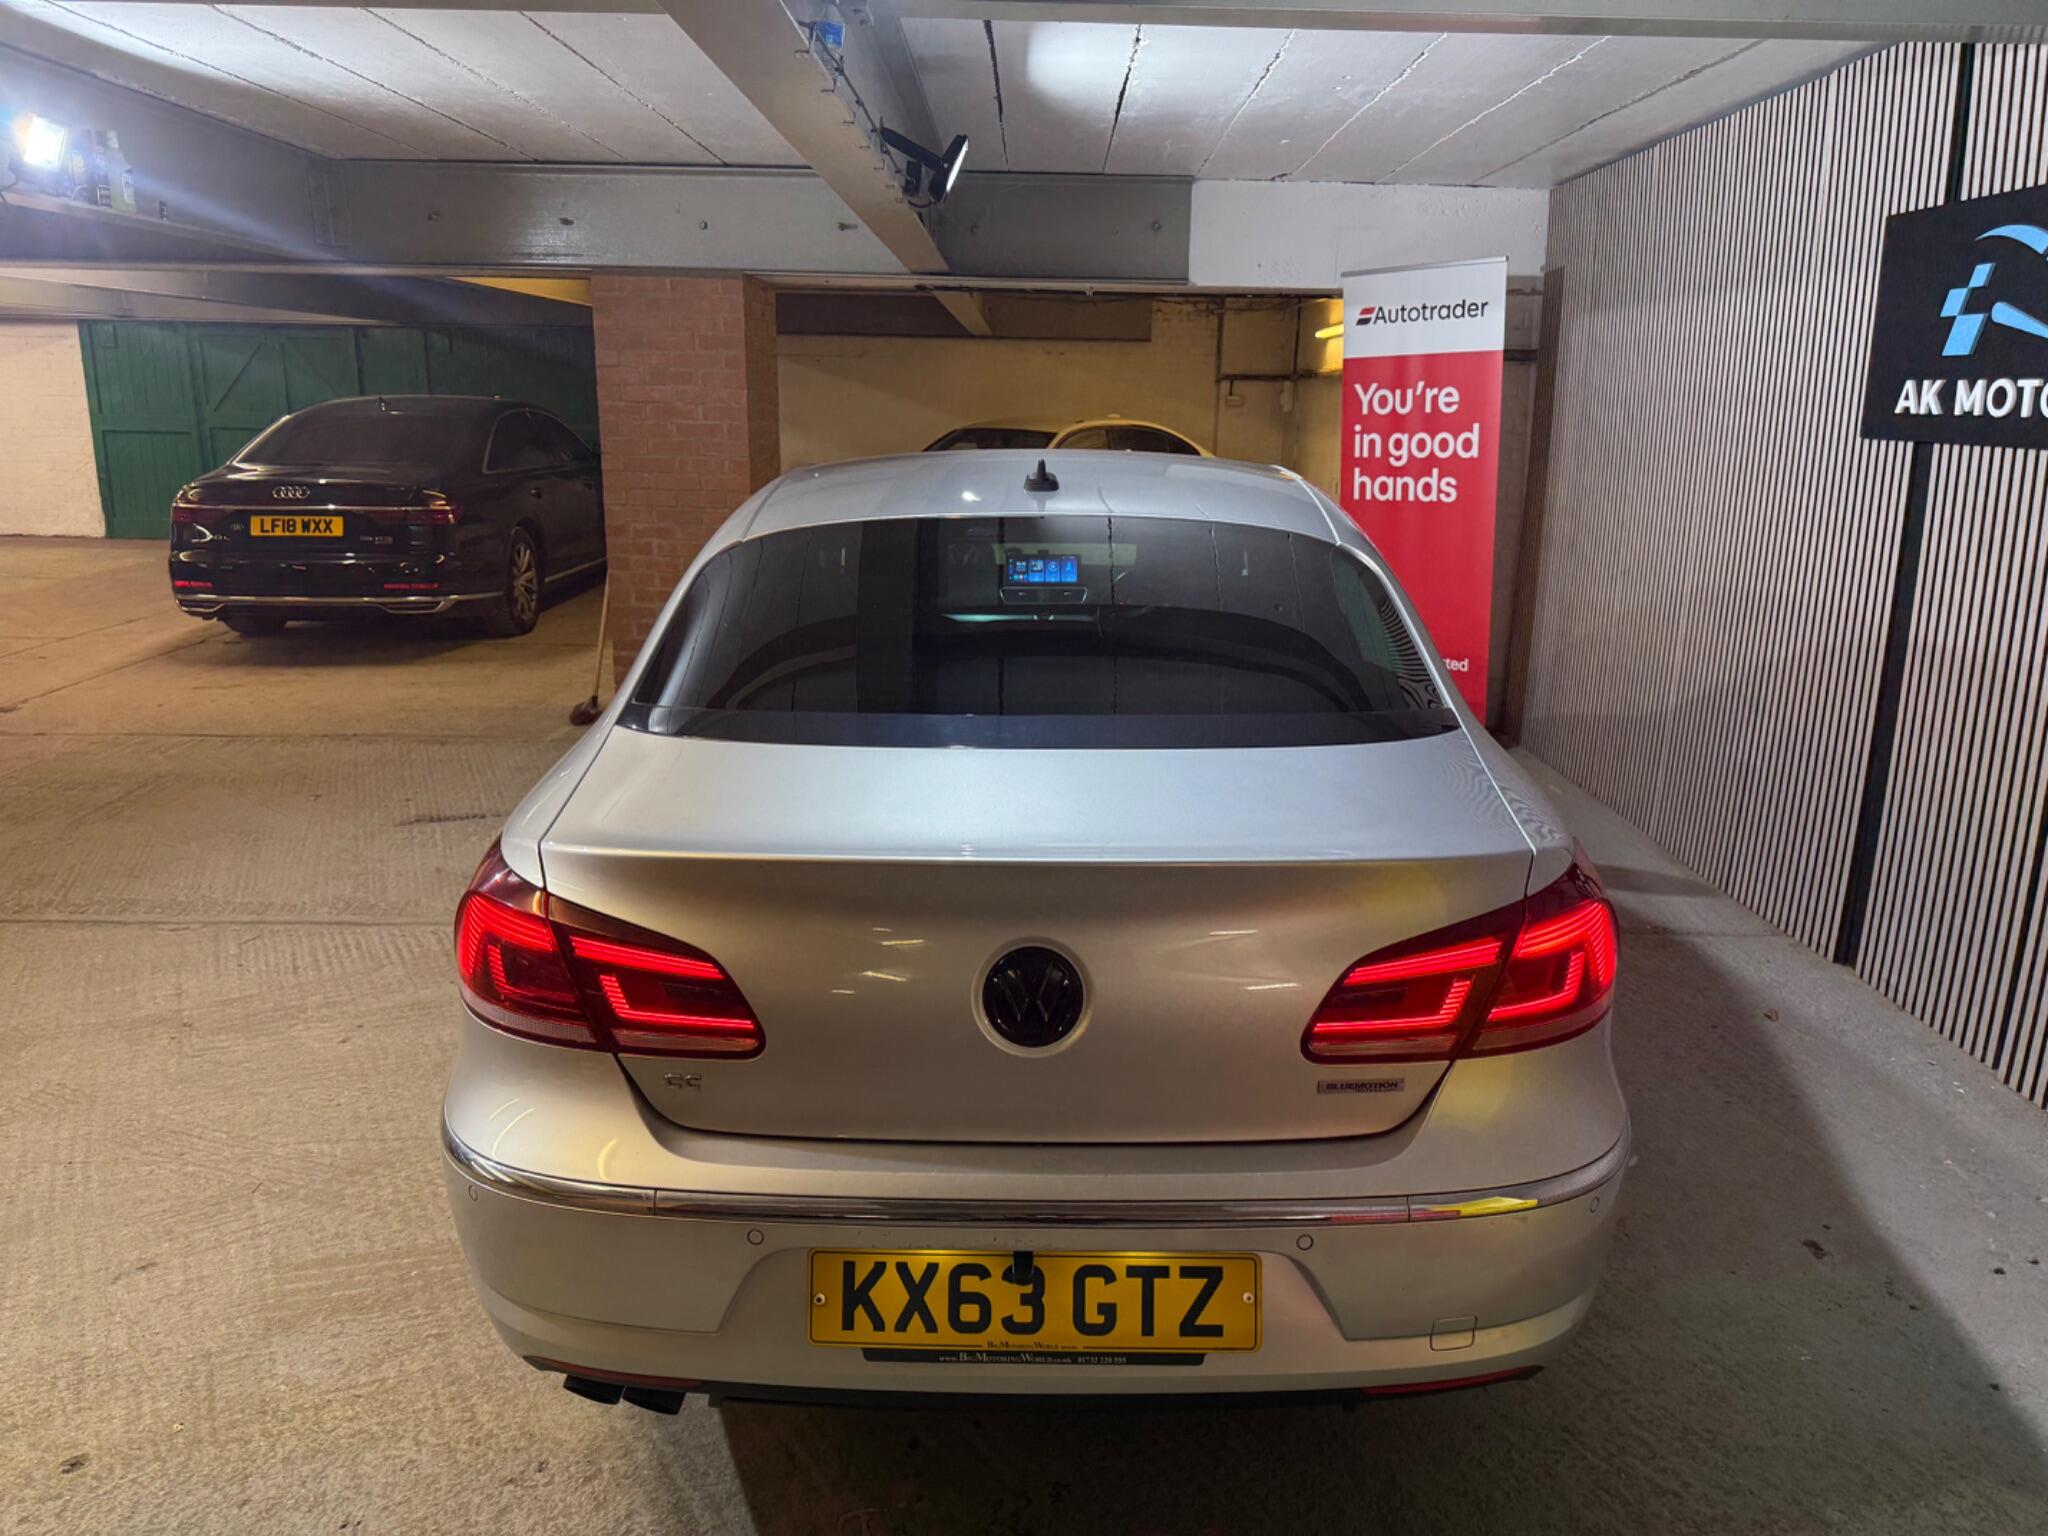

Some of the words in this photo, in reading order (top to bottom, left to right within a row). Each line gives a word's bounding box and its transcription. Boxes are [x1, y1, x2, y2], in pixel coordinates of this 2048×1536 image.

[1373, 299, 1489, 325] Autotrader
[1354, 380, 1460, 415] You're
[1894, 378, 1947, 416] AK
[1953, 378, 2048, 418] MOT
[1353, 424, 1382, 459] in
[1388, 423, 1480, 467] good
[1353, 468, 1457, 503] hands
[260, 518, 297, 533] LF18
[301, 518, 333, 533] WXX
[842, 1260, 1046, 1335] KX63
[1072, 1264, 1224, 1338] GTZ
